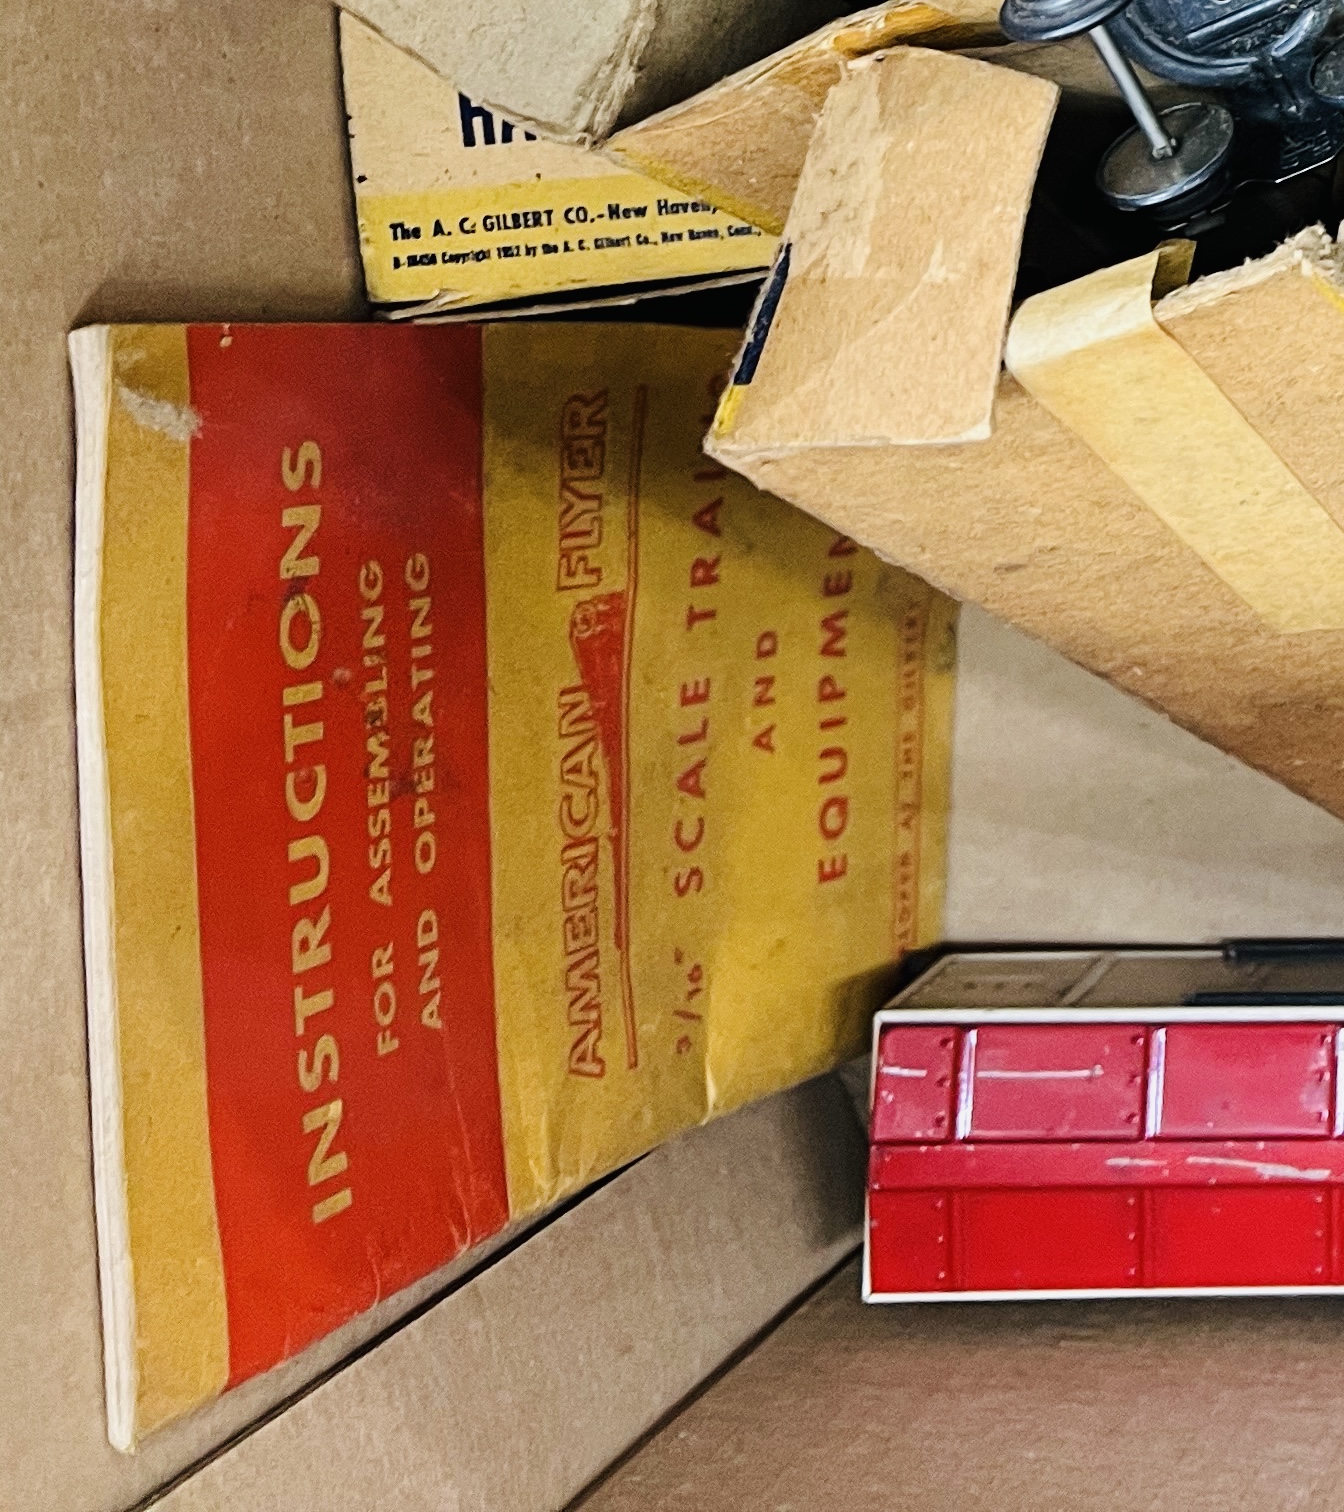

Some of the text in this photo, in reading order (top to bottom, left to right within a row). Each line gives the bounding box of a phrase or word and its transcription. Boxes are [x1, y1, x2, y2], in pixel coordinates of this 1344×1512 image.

[389, 222, 422, 241] The
[431, 220, 452, 238] A.
[482, 208, 554, 233] GILBERT
[279, 439, 353, 1226] INSTRUCTIONS
[358, 558, 400, 1057] FOR ASSEMBLING
[403, 551, 443, 1030] AND OPERATING
[556, 386, 610, 1080] AMERICAN FLYER
[672, 676, 712, 898] SCALE
[751, 630, 779, 754] AND
